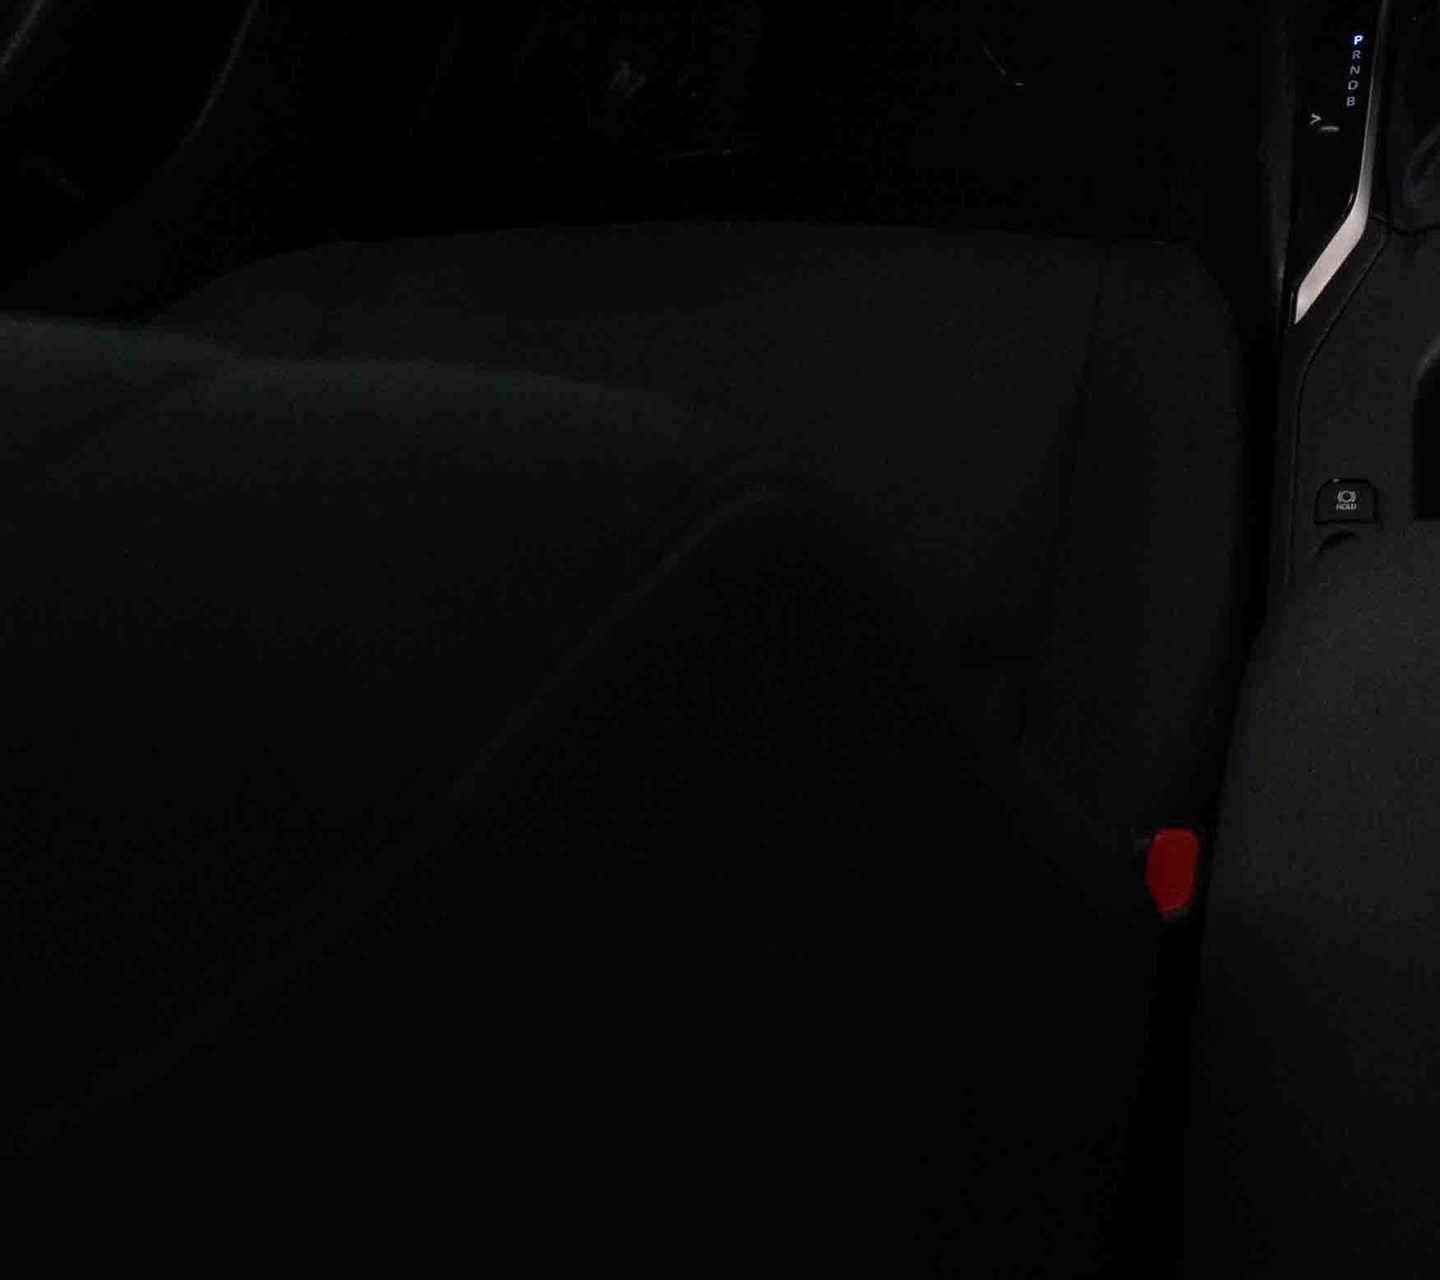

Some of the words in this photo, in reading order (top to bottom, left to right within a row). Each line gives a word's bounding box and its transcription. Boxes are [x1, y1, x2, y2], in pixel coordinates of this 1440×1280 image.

[1353, 35, 1364, 45] P
[1352, 49, 1361, 60] R
[1349, 65, 1360, 75] N
[1347, 80, 1359, 90] D
[1346, 96, 1356, 107] B
